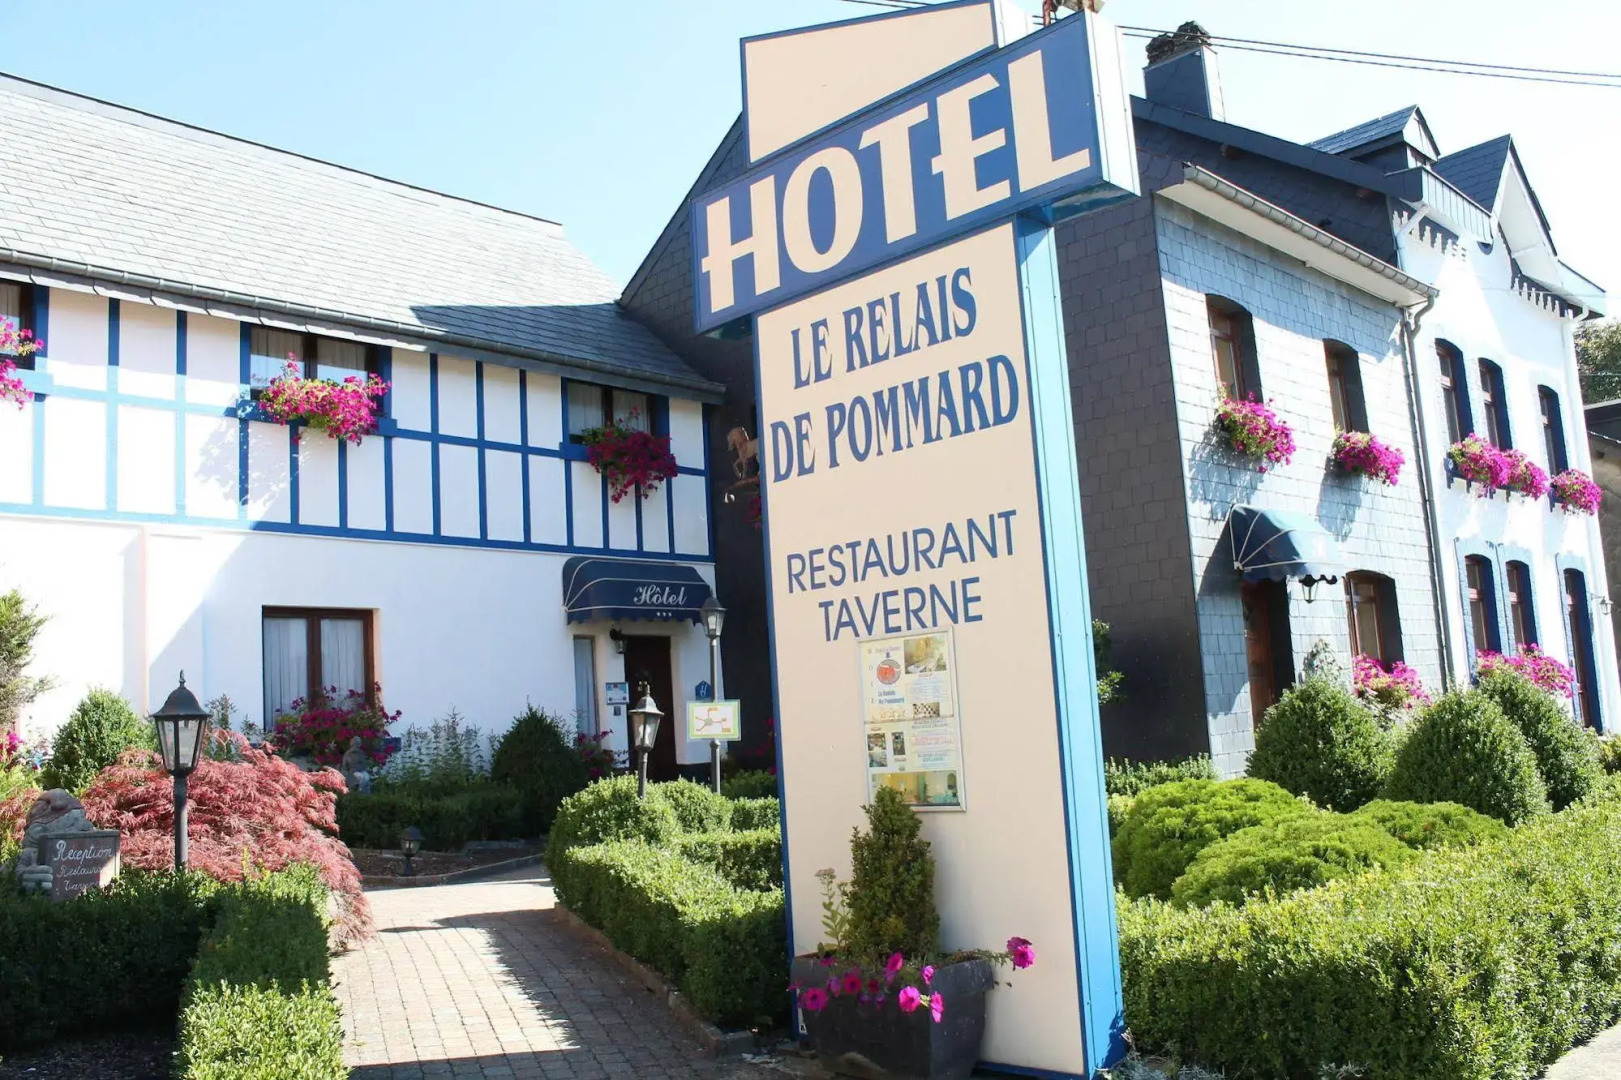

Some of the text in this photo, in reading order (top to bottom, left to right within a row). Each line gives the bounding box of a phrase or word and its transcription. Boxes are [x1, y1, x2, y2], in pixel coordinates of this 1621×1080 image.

[702, 49, 1090, 313] HOTEL
[791, 266, 977, 389] LE RELAIS
[770, 354, 1019, 483] DE POMMARD
[633, 584, 687, 605] Hôtel
[787, 509, 1017, 593] RESTAURANT
[818, 577, 983, 642] TAVERNE
